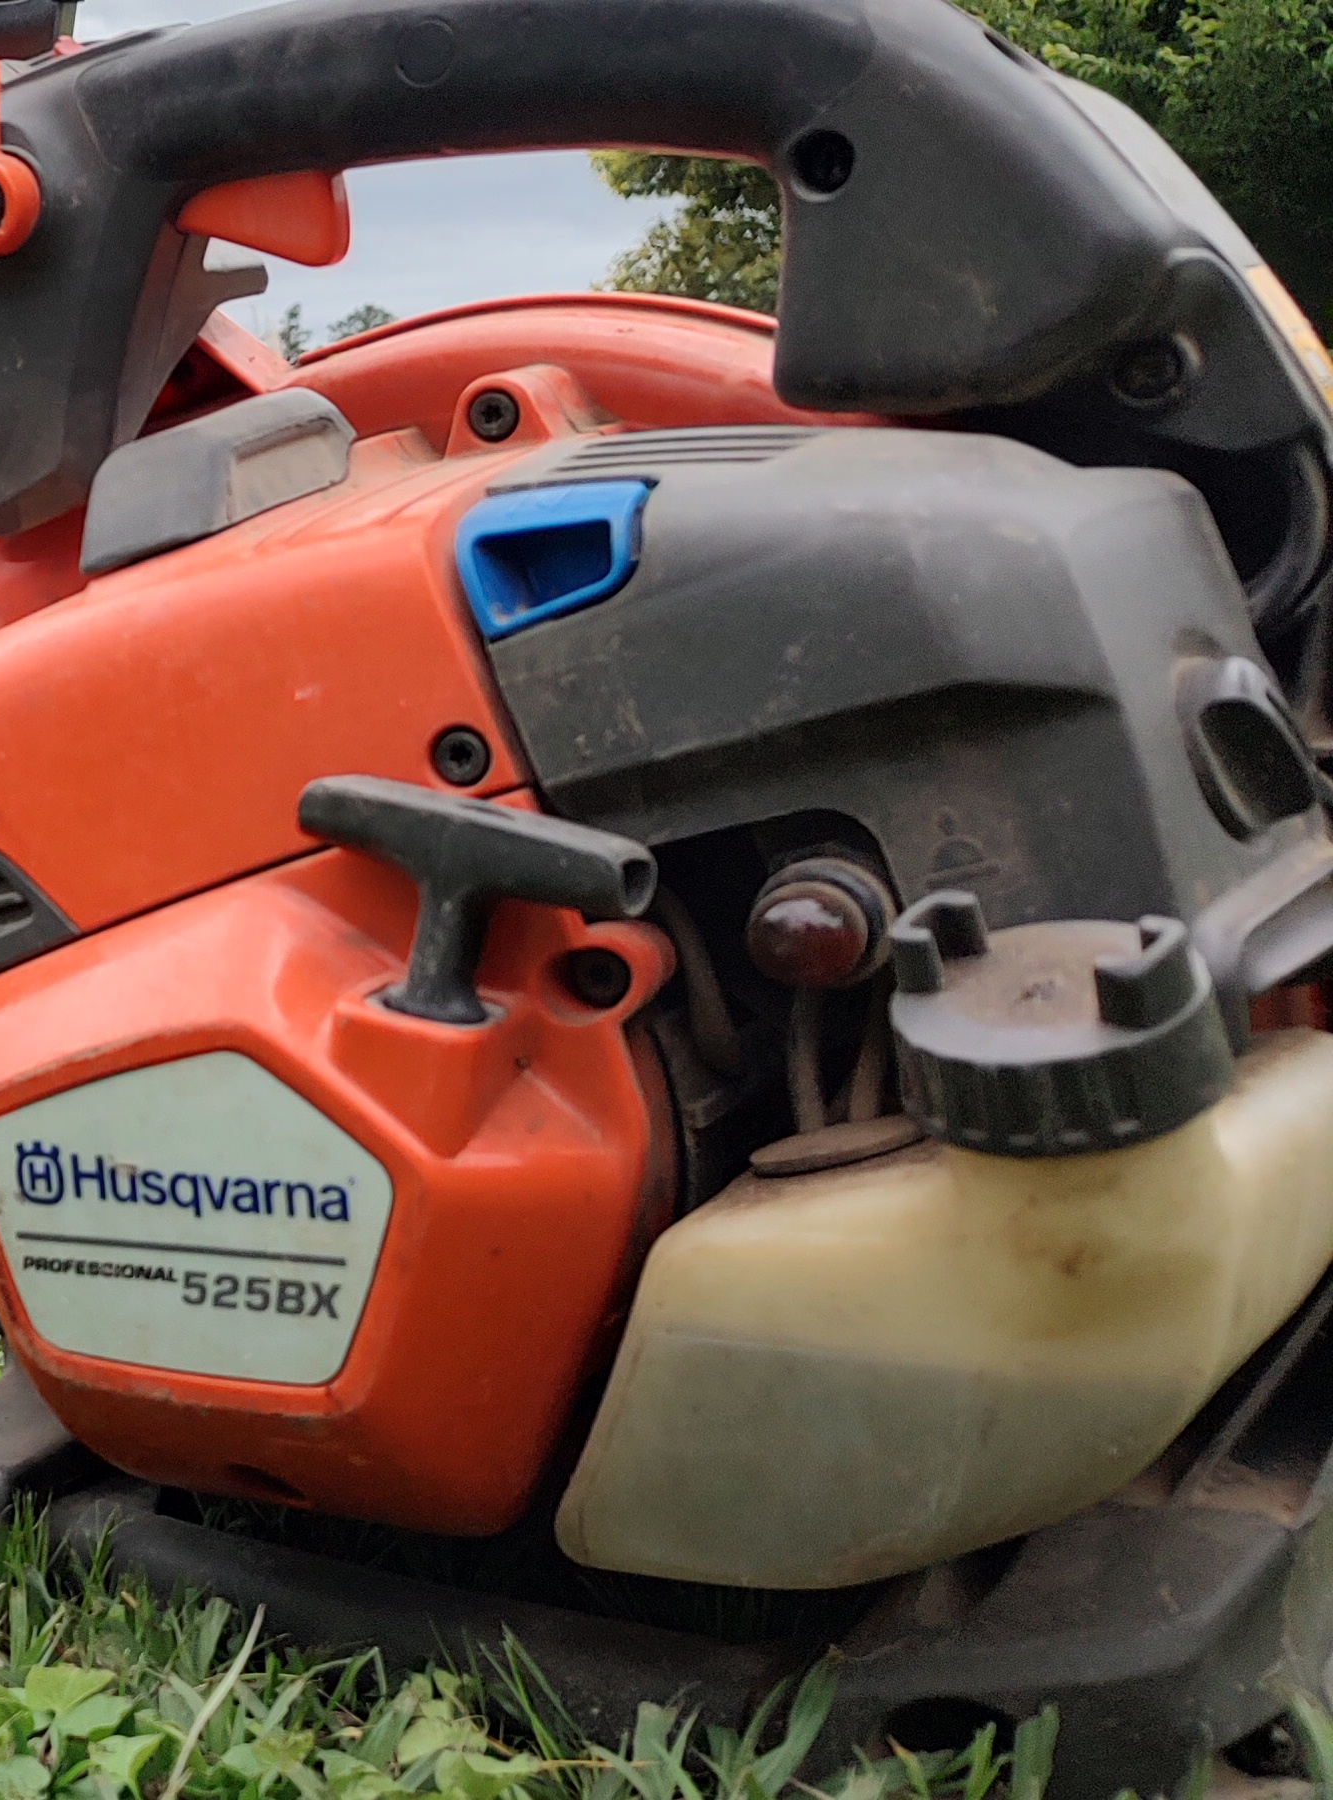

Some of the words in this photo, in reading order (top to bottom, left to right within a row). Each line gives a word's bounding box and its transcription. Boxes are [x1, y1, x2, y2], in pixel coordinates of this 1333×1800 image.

[70, 1154, 350, 1222] Husqvarna
[23, 1255, 178, 1283] PROFESSIONAL
[181, 1271, 342, 1319] 525BX
